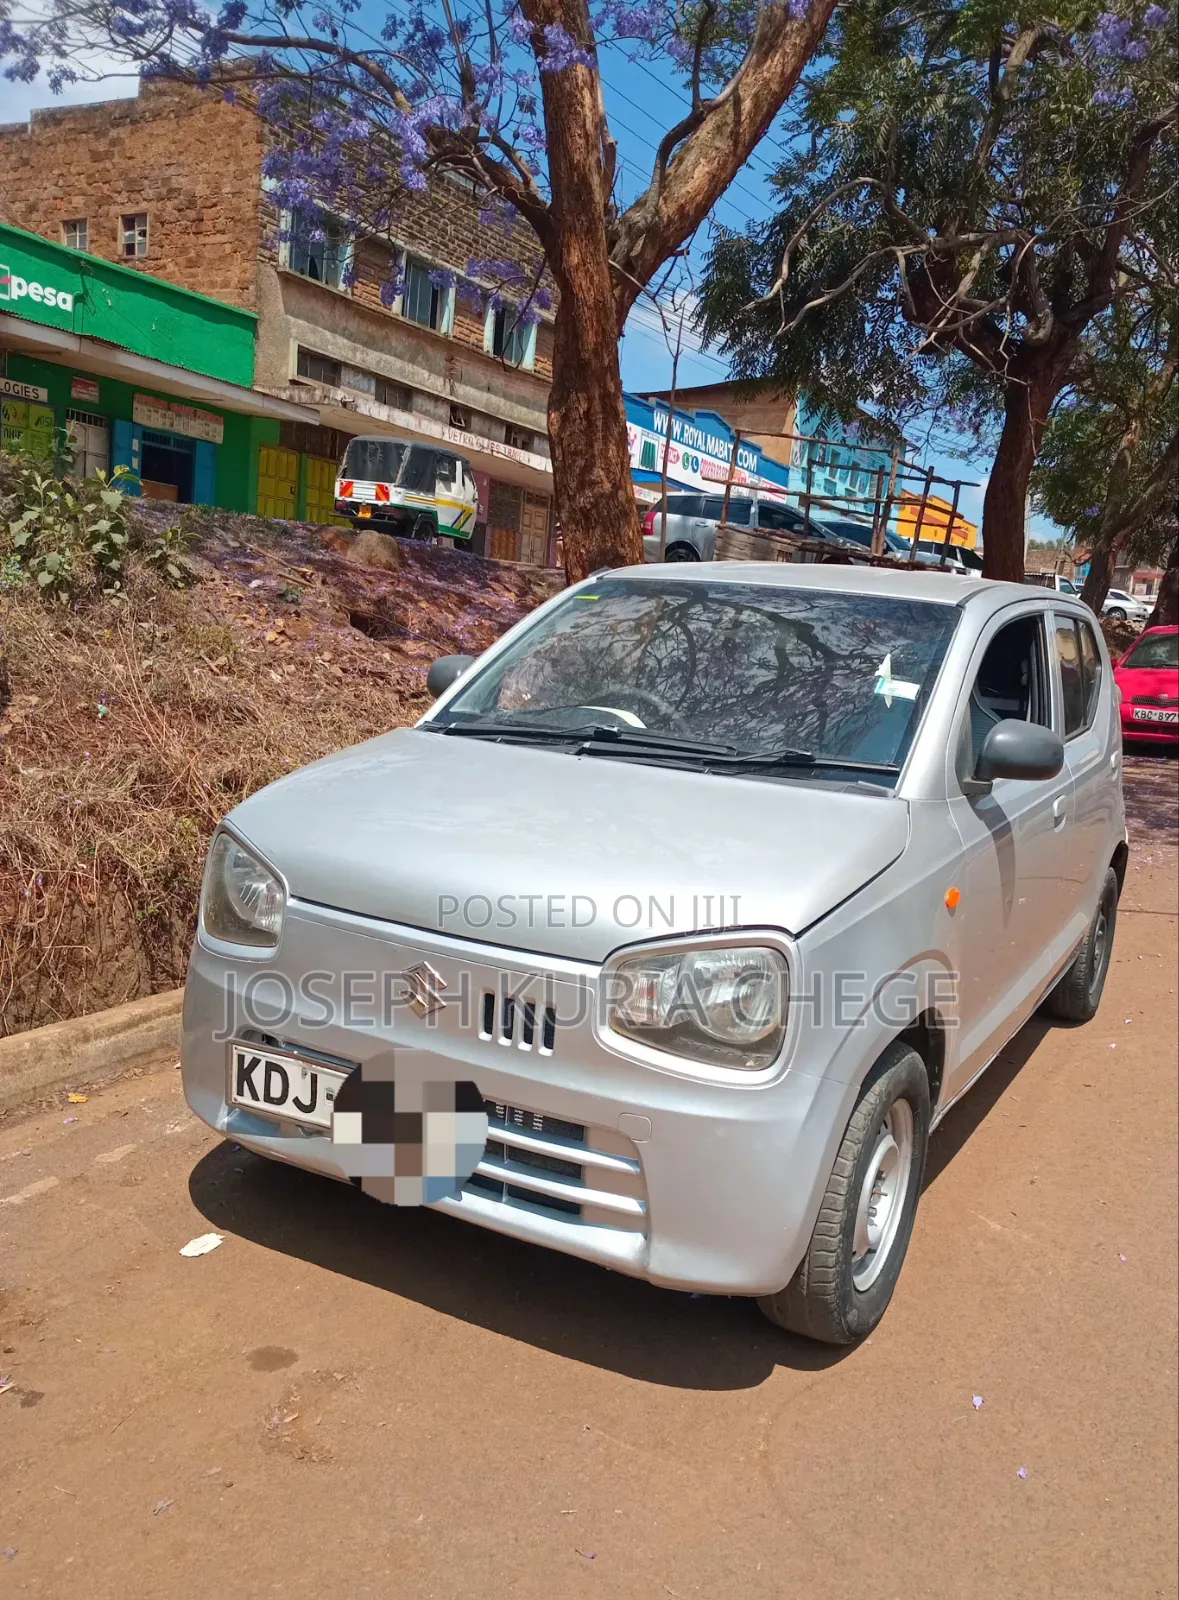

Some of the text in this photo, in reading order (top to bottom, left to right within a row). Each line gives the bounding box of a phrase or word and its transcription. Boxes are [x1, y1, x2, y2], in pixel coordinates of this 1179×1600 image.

[11, 274, 73, 312] pesa
[1134, 709, 1177, 722] KBC 897
[236, 1053, 318, 1114] KDJ
